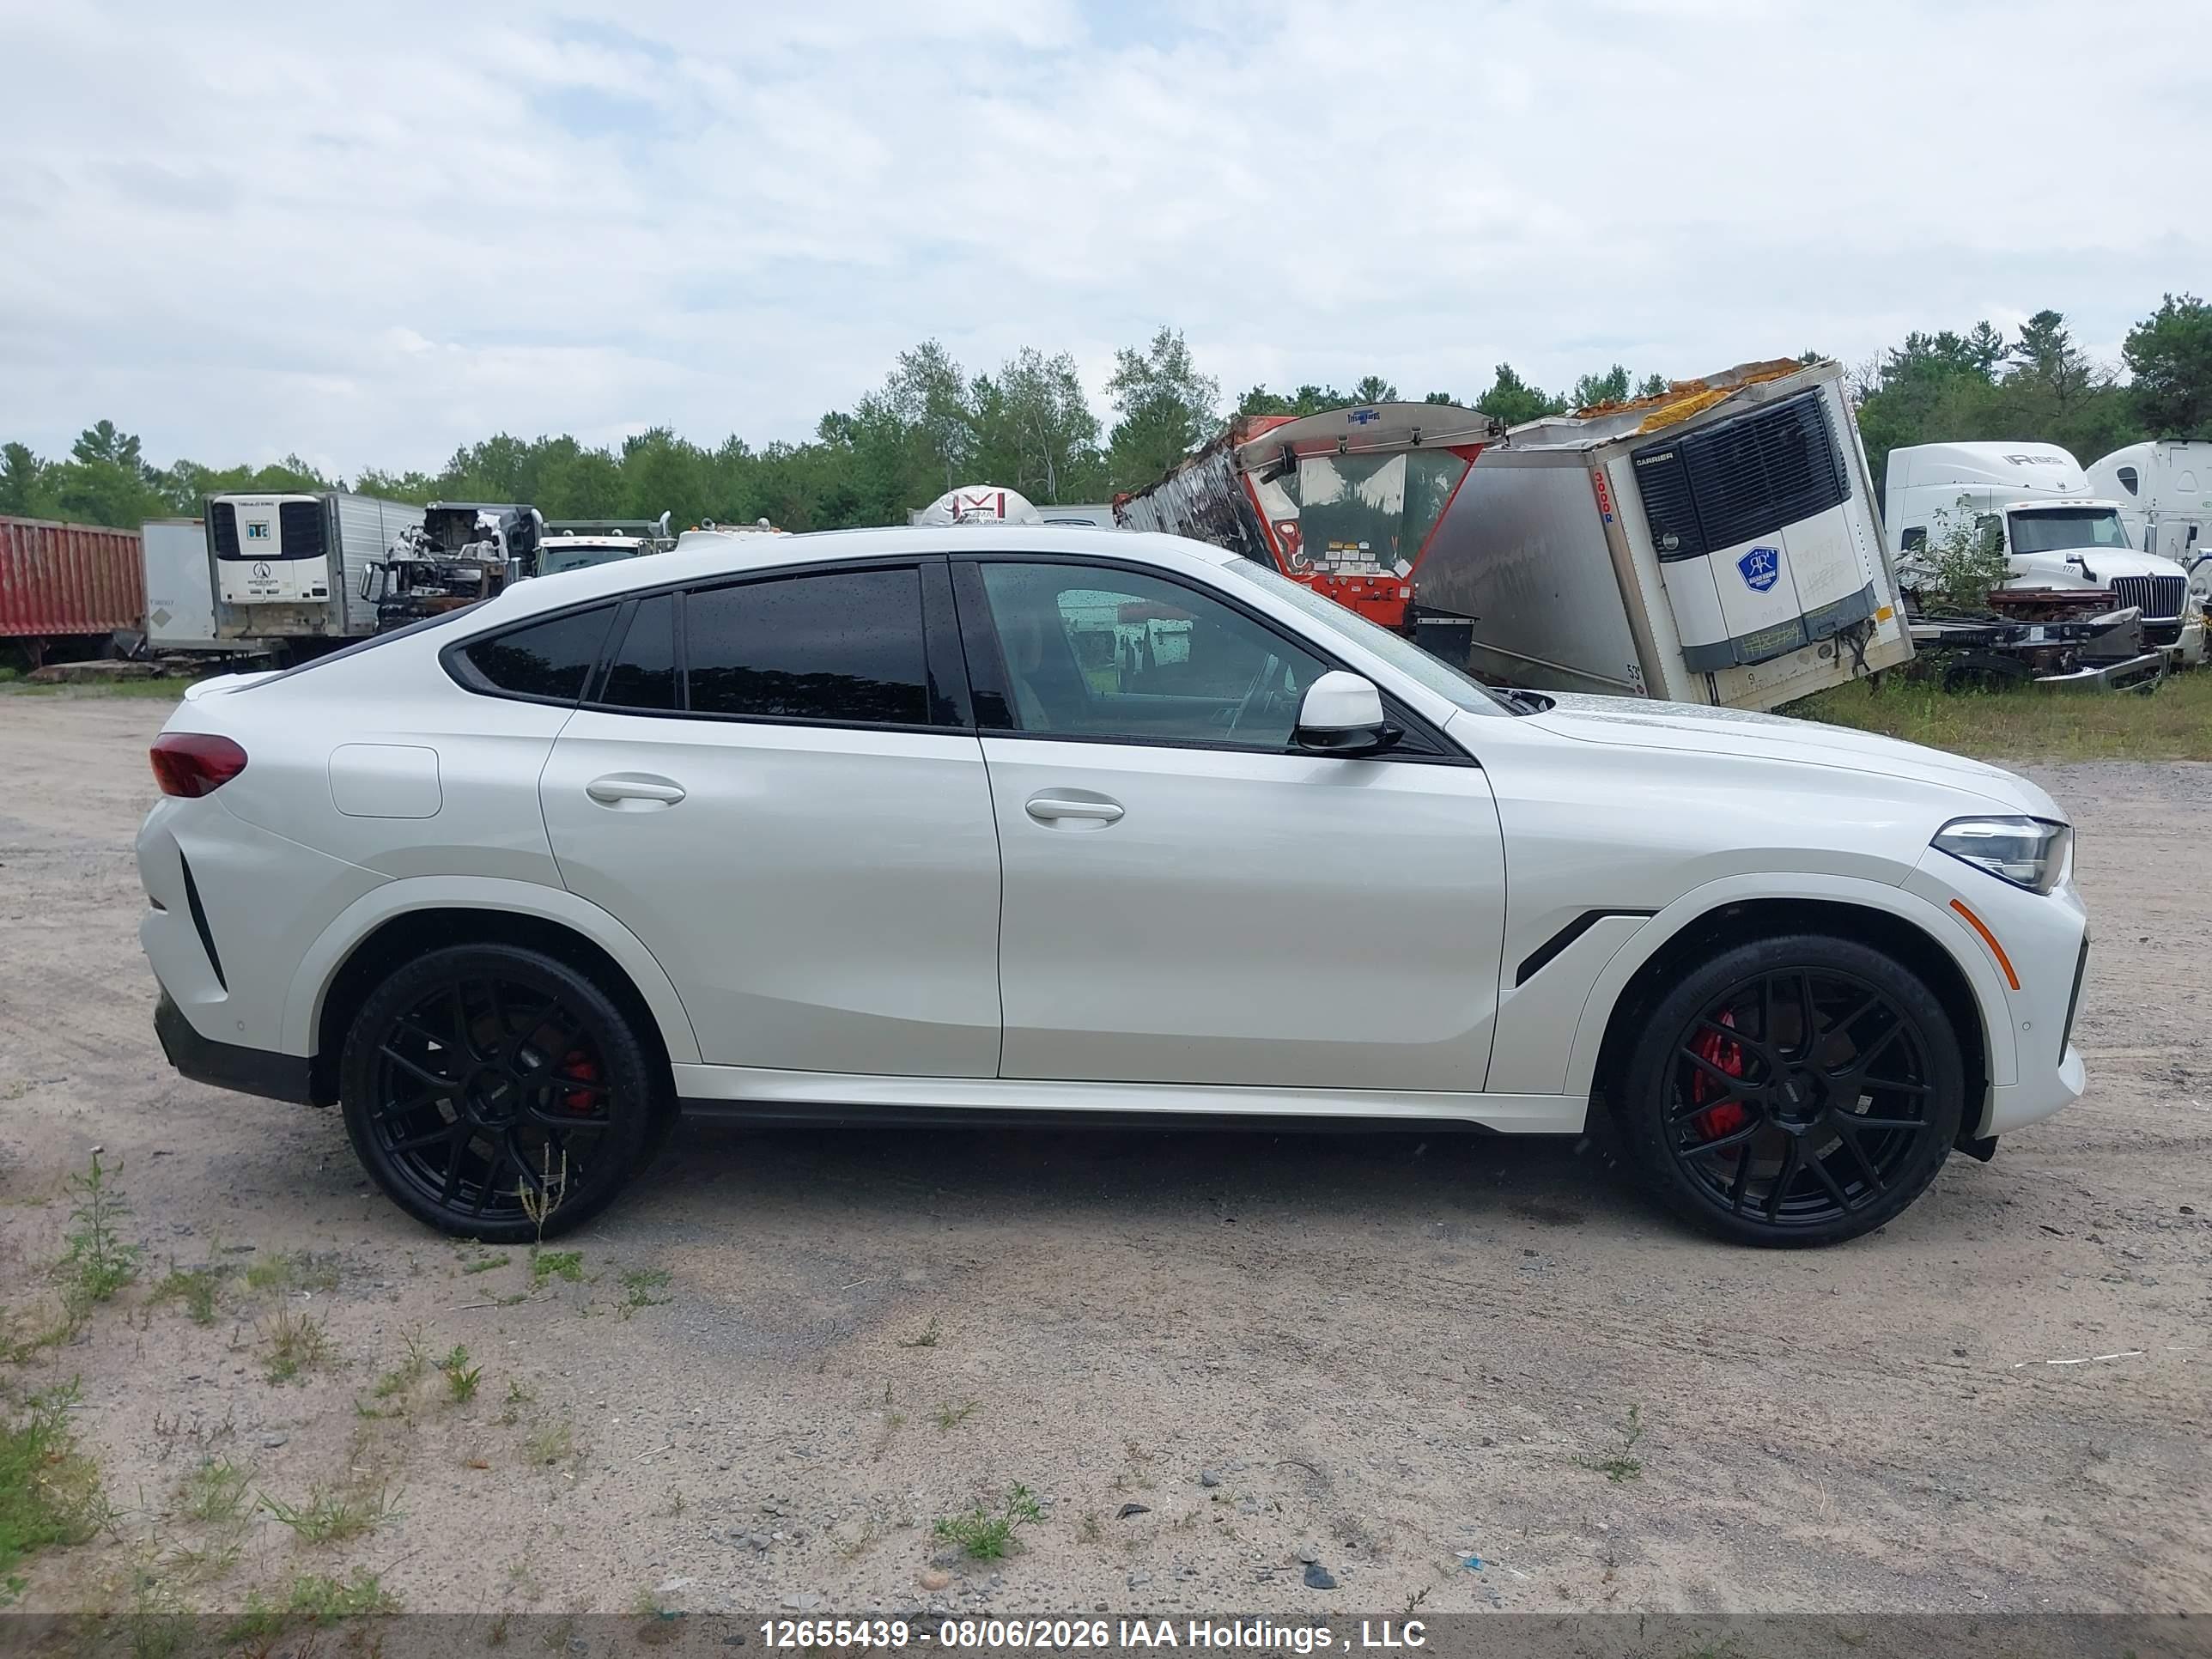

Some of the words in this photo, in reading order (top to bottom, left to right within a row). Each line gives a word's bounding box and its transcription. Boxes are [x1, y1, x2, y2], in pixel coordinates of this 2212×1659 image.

[1636, 452, 1674, 466] CARRIER
[1595, 472, 1613, 523] 3000R
[2062, 565, 2076, 574] 177
